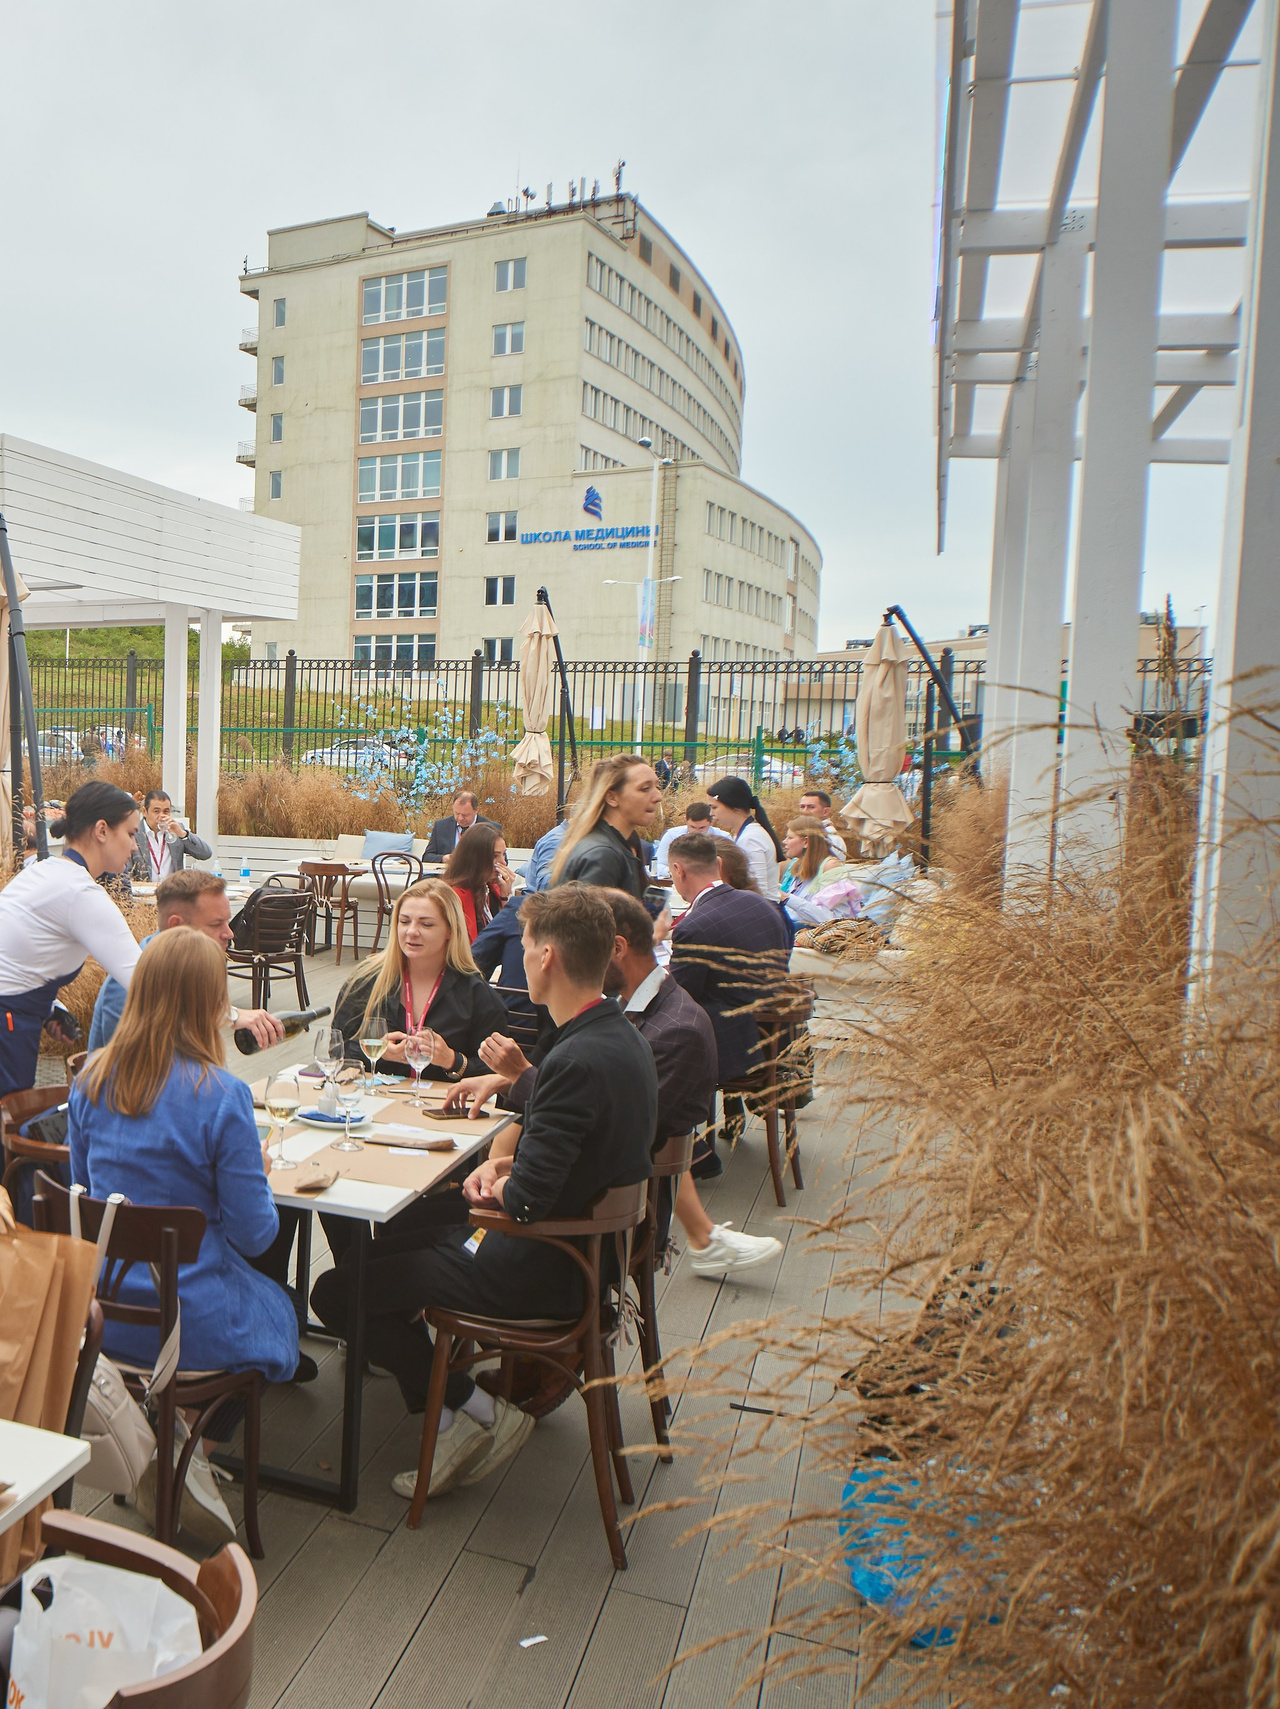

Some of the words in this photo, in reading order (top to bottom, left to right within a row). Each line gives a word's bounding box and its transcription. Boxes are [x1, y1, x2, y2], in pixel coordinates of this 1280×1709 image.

[520, 530, 572, 544] ШКОЛА
[575, 525, 659, 541] МЕДИЦИНЫ
[573, 543, 605, 551] SCHOOL
